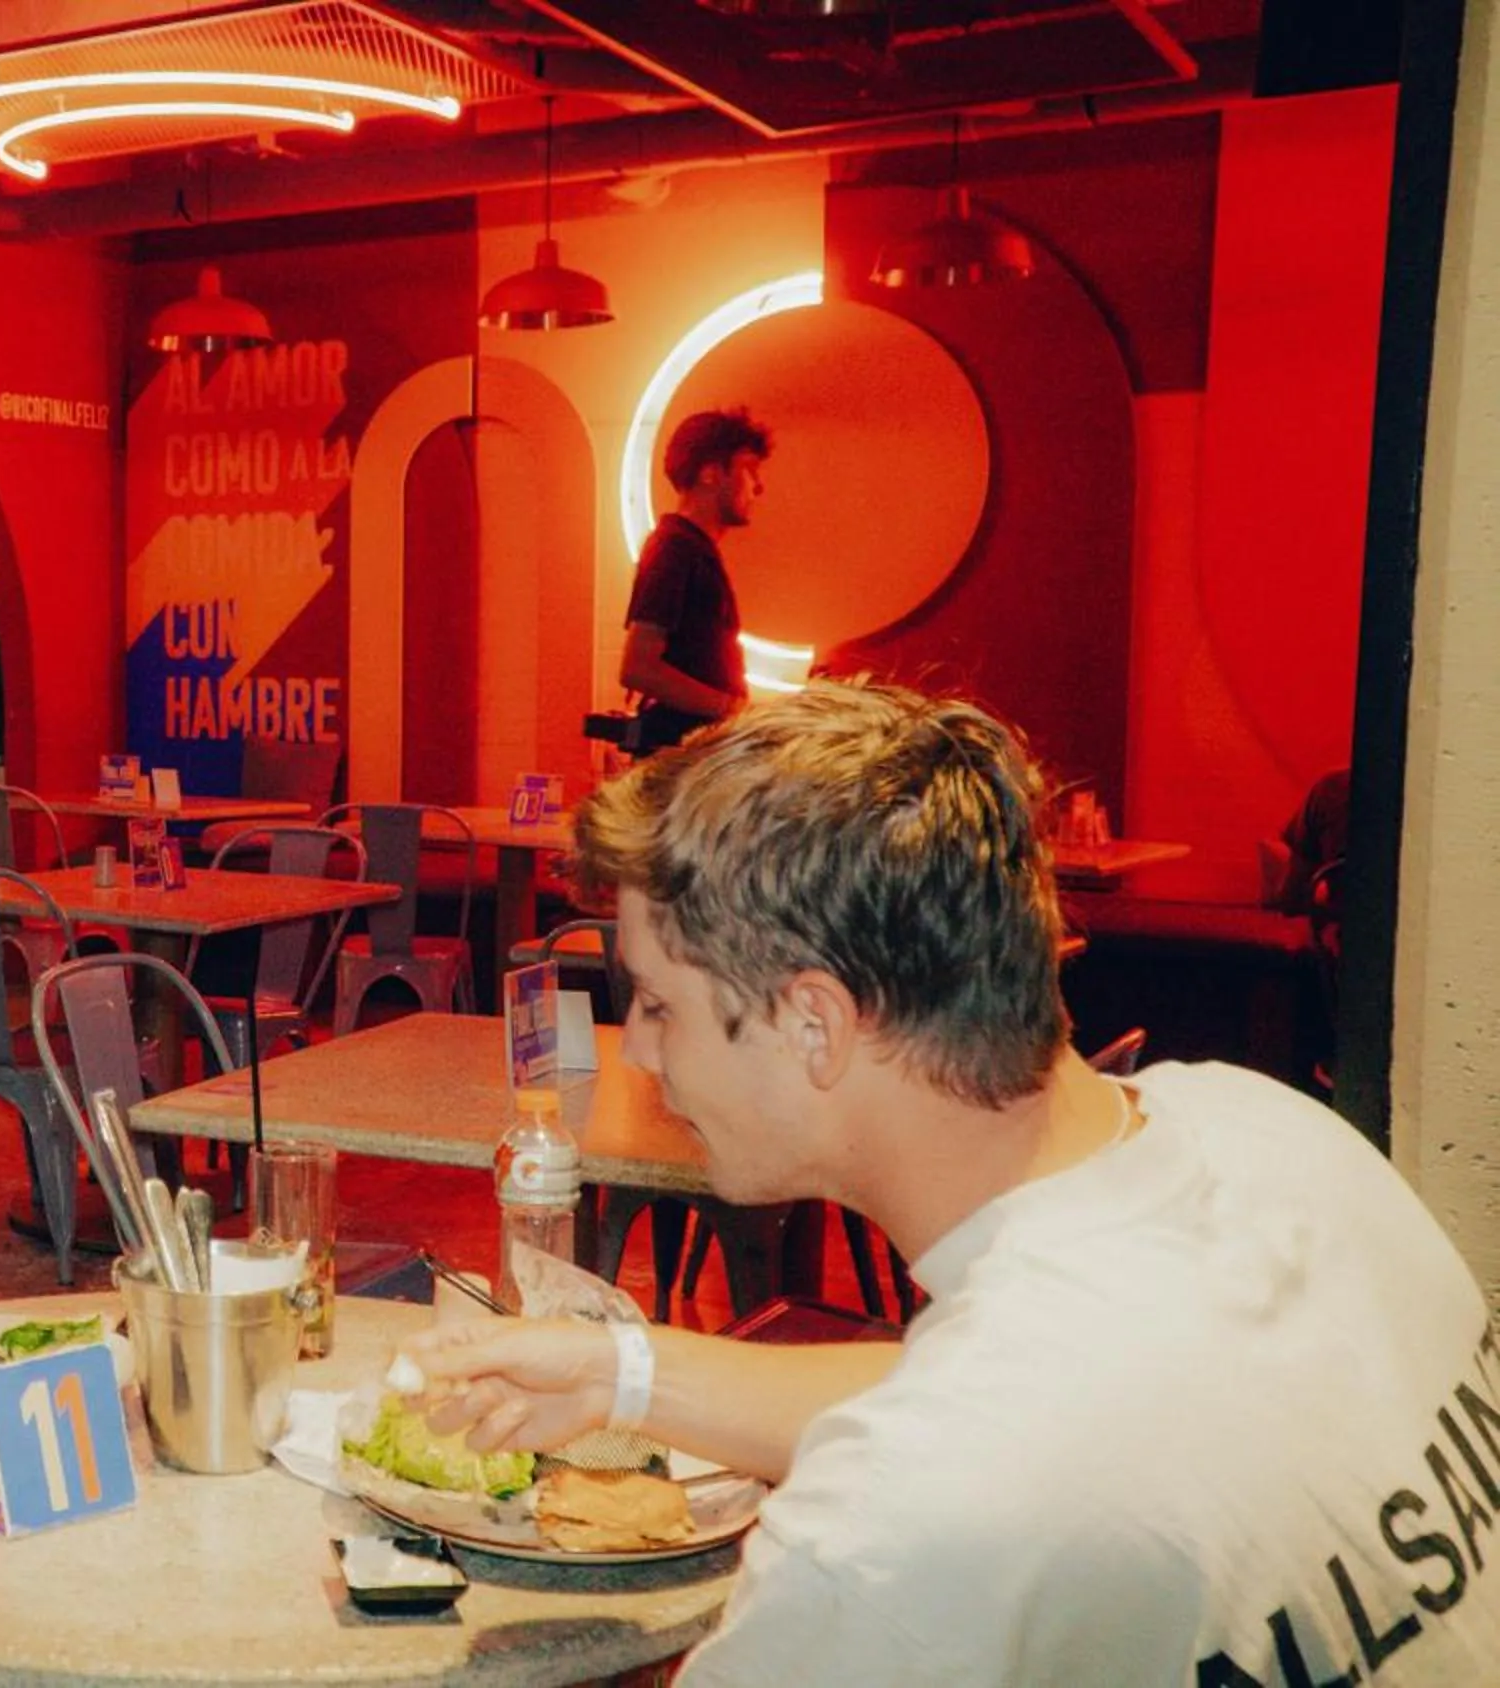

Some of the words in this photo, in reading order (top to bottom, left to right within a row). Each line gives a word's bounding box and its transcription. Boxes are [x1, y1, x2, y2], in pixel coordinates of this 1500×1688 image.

[165, 353, 213, 415] AL
[227, 340, 349, 412] AMOR
[165, 429, 280, 497] COMO
[289, 438, 311, 481] A
[317, 436, 355, 479] LA
[164, 598, 238, 660] CON
[165, 677, 341, 743] HAMBRE
[20, 1372, 102, 1512] 11
